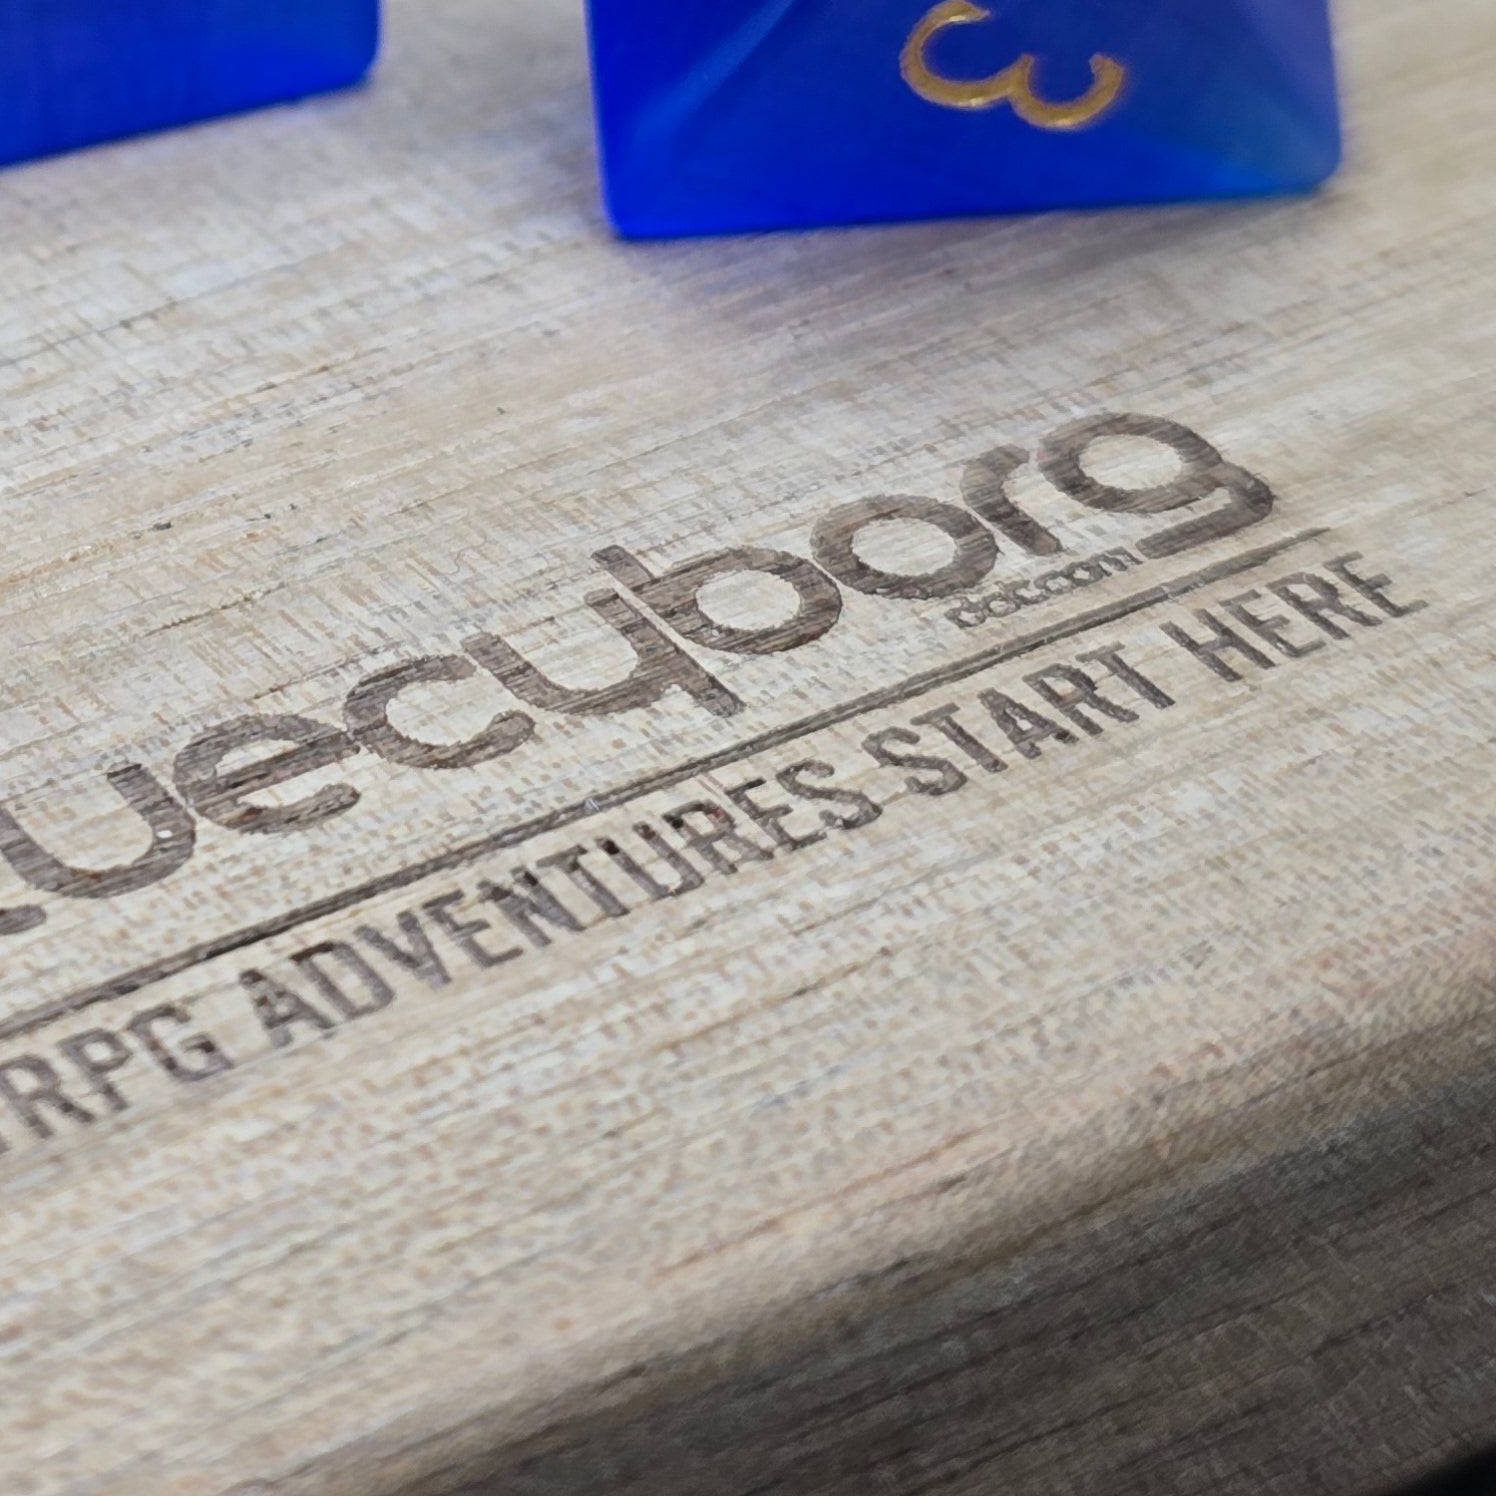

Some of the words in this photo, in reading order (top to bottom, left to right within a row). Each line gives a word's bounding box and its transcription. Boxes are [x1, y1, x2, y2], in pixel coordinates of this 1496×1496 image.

[239, 758, 884, 1049] ADVENTURES
[860, 642, 1178, 798] START
[1160, 552, 1432, 684] HERE
